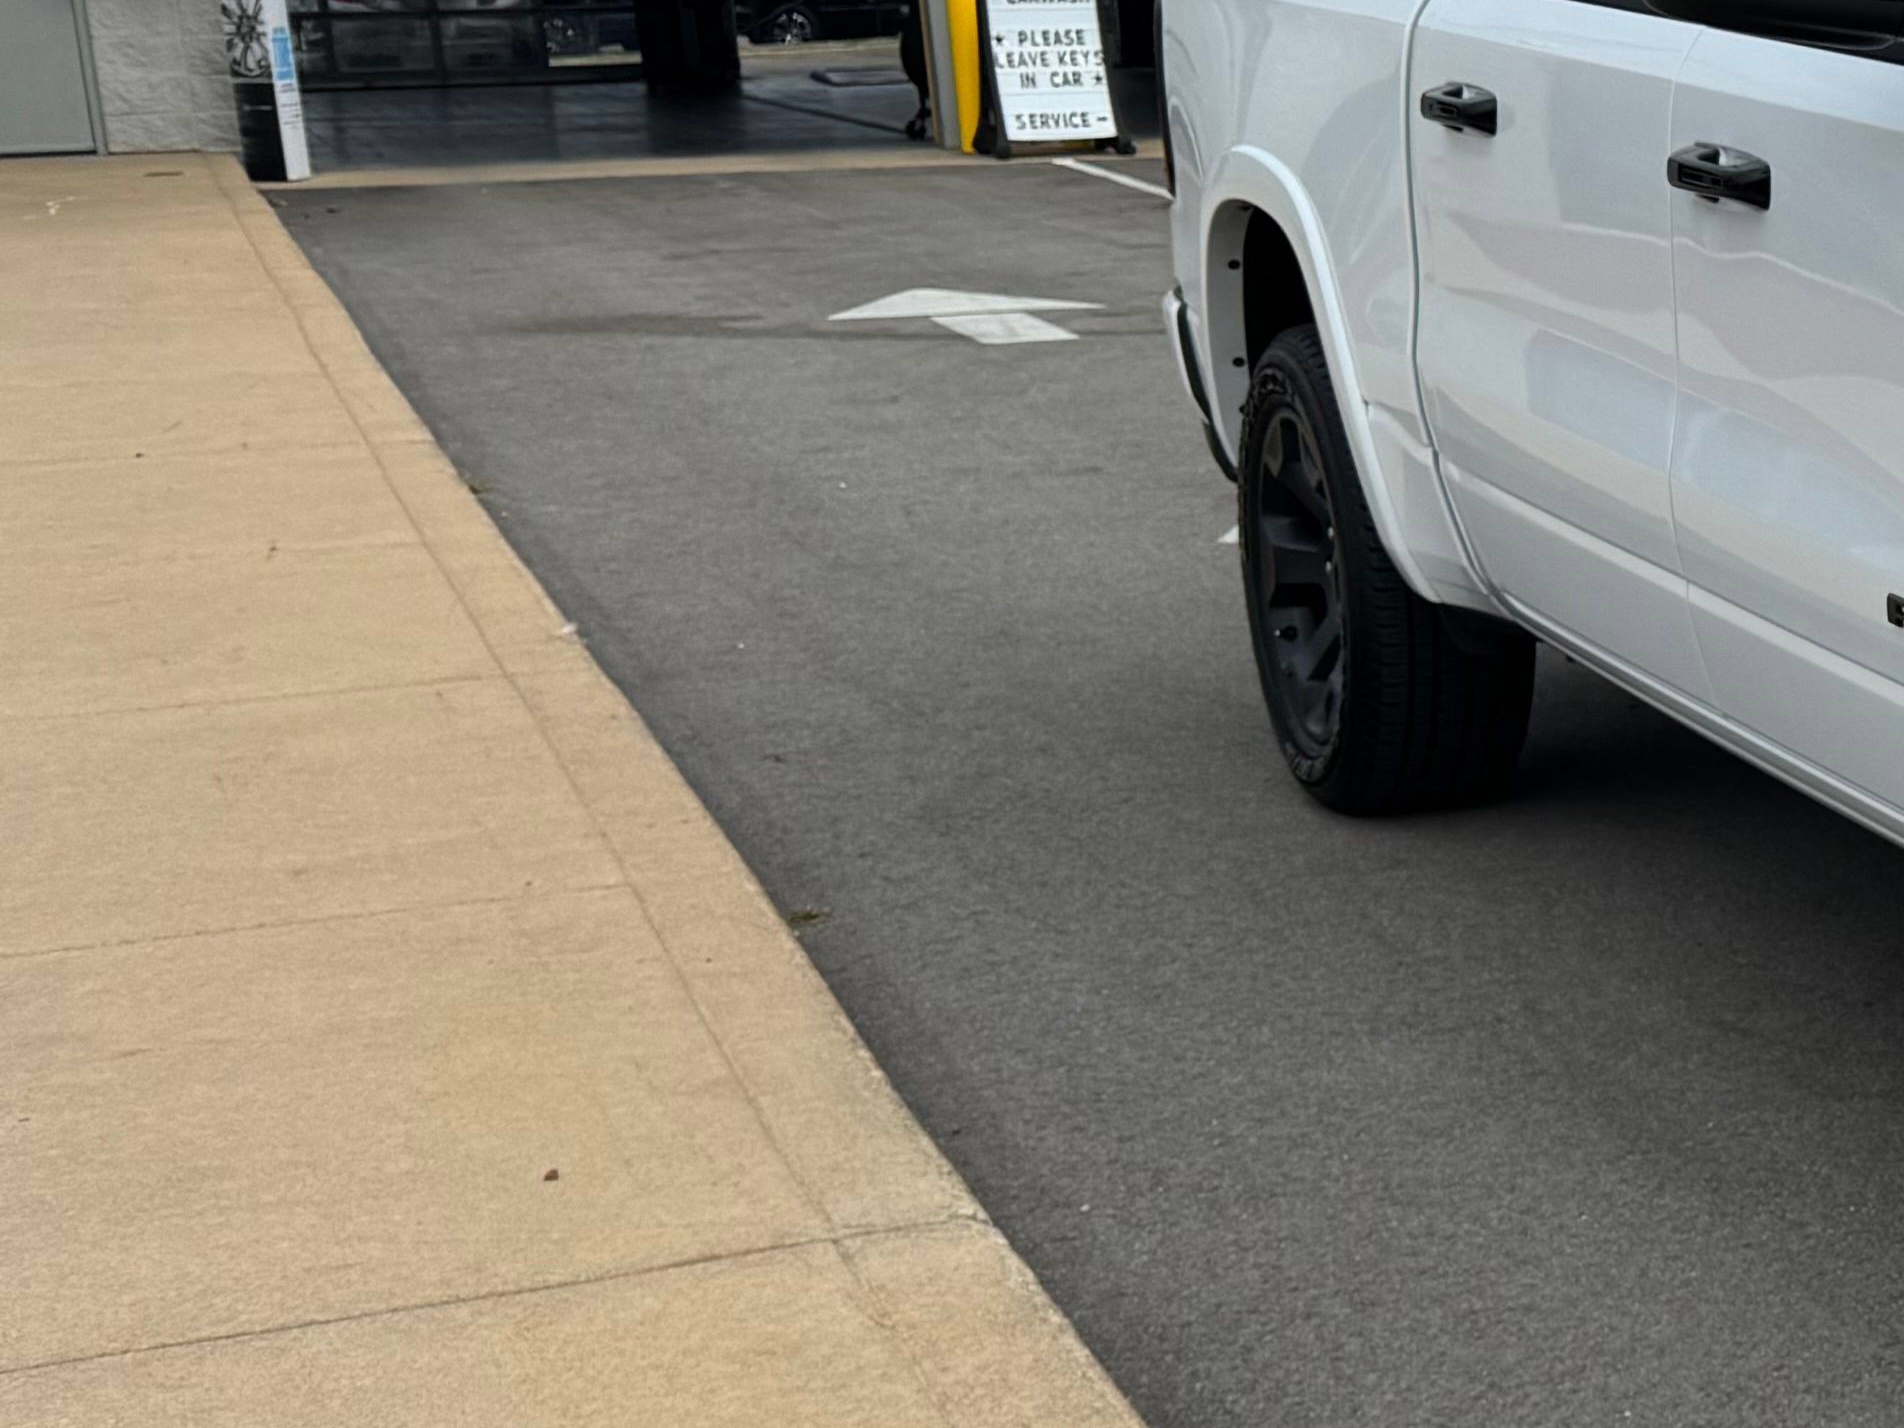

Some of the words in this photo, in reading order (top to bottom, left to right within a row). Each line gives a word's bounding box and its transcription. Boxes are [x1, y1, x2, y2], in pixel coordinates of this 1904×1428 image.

[1018, 29, 1085, 47] PLEASE
[994, 50, 1050, 69] LEAVE
[1058, 49, 1105, 66] KEYS
[1020, 73, 1036, 89] IN
[1050, 72, 1083, 88] CAR
[1015, 112, 1091, 129] SERVICE
